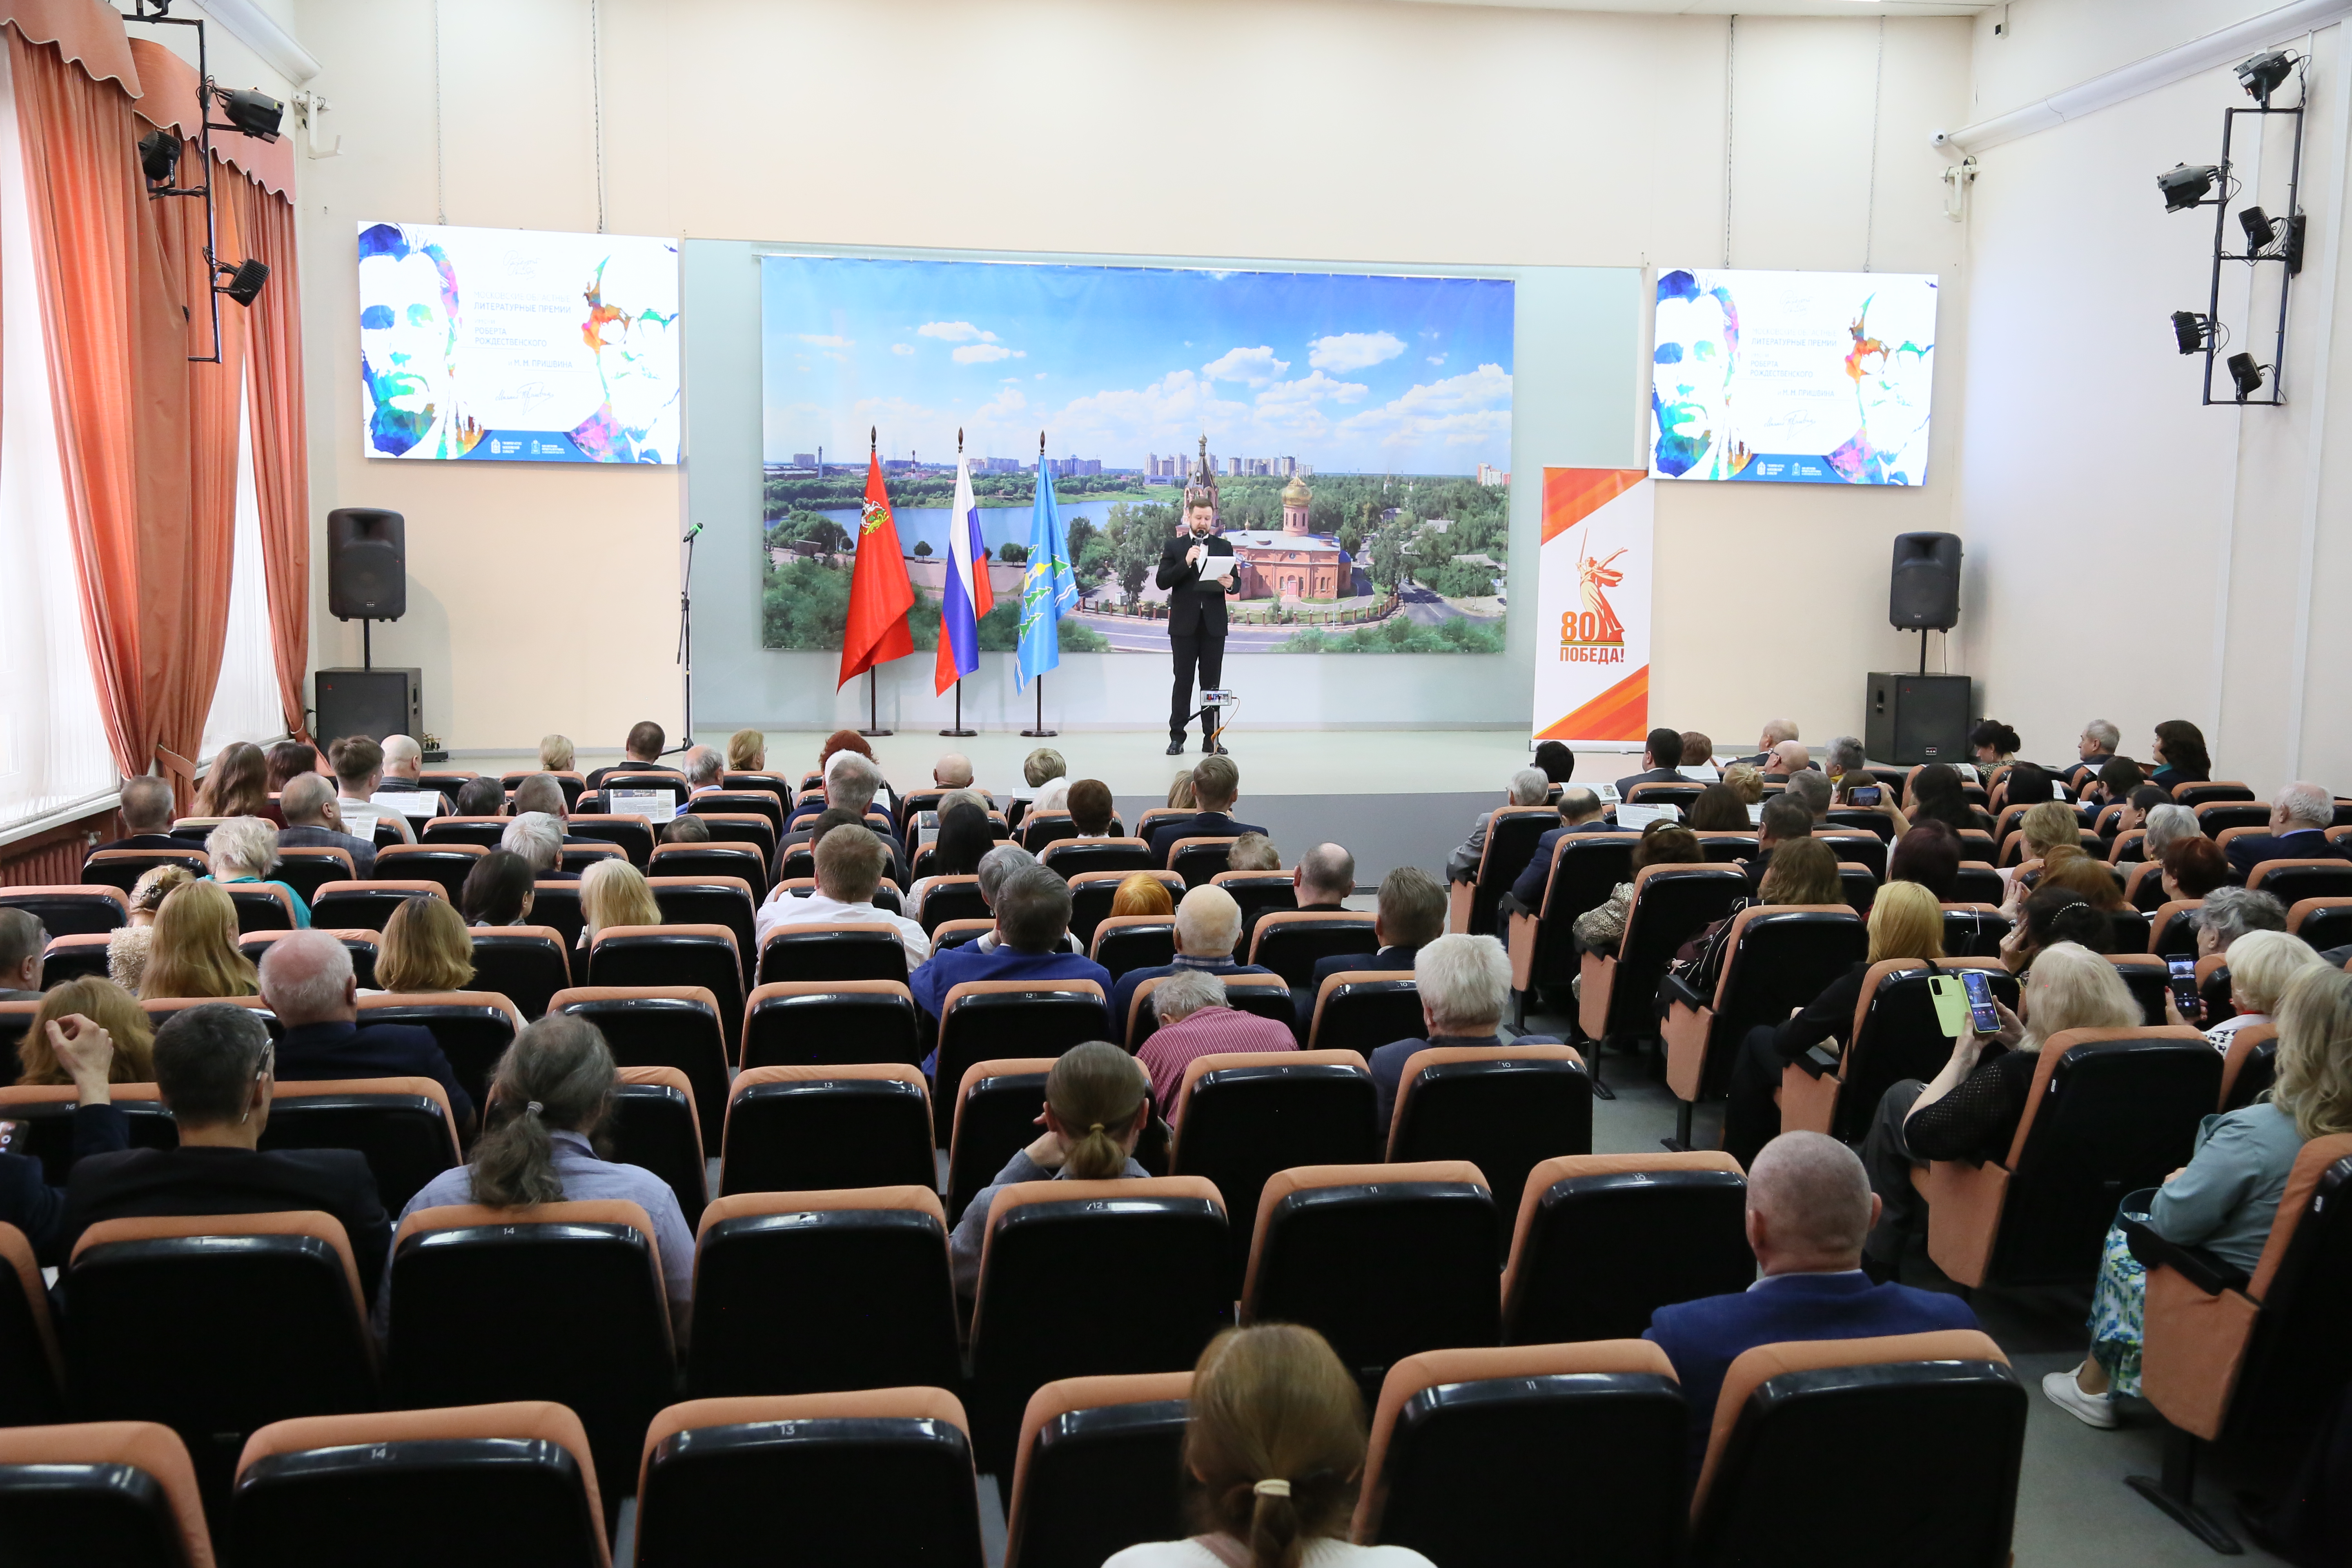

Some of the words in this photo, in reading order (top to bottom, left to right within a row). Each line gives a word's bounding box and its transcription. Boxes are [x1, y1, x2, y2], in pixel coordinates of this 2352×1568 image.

[526, 292, 571, 303] ОБАСТНЫЕ
[473, 301, 537, 312] ЛИТЕРАТУРНЫЕ
[538, 304, 571, 314] ПРЕМИИ
[474, 327, 507, 335] РОБЕРТА
[1797, 328, 1837, 337] ОБАСТНЫЕ
[475, 337, 547, 347] РОЖДЕСТВЕНСКОГО
[1751, 338, 1806, 347] ЛИТЕРАТУРНЫЕ
[1807, 339, 1837, 347] ПРЕМИИ
[532, 360, 572, 368] ПРИШВИНА
[1750, 370, 1813, 378] РОЖДЕСТВЕНСКОГО
[1561, 611, 1595, 641] 80
[1560, 647, 1624, 664] ПОБЕДА!
[1638, 896, 1642, 905] 5
[1740, 939, 1743, 949] 6
[2051, 1079, 2056, 1092] 8
[1526, 1380, 1536, 1390] 11
[781, 1424, 795, 1435] 13
[371, 1448, 386, 1459] 14
